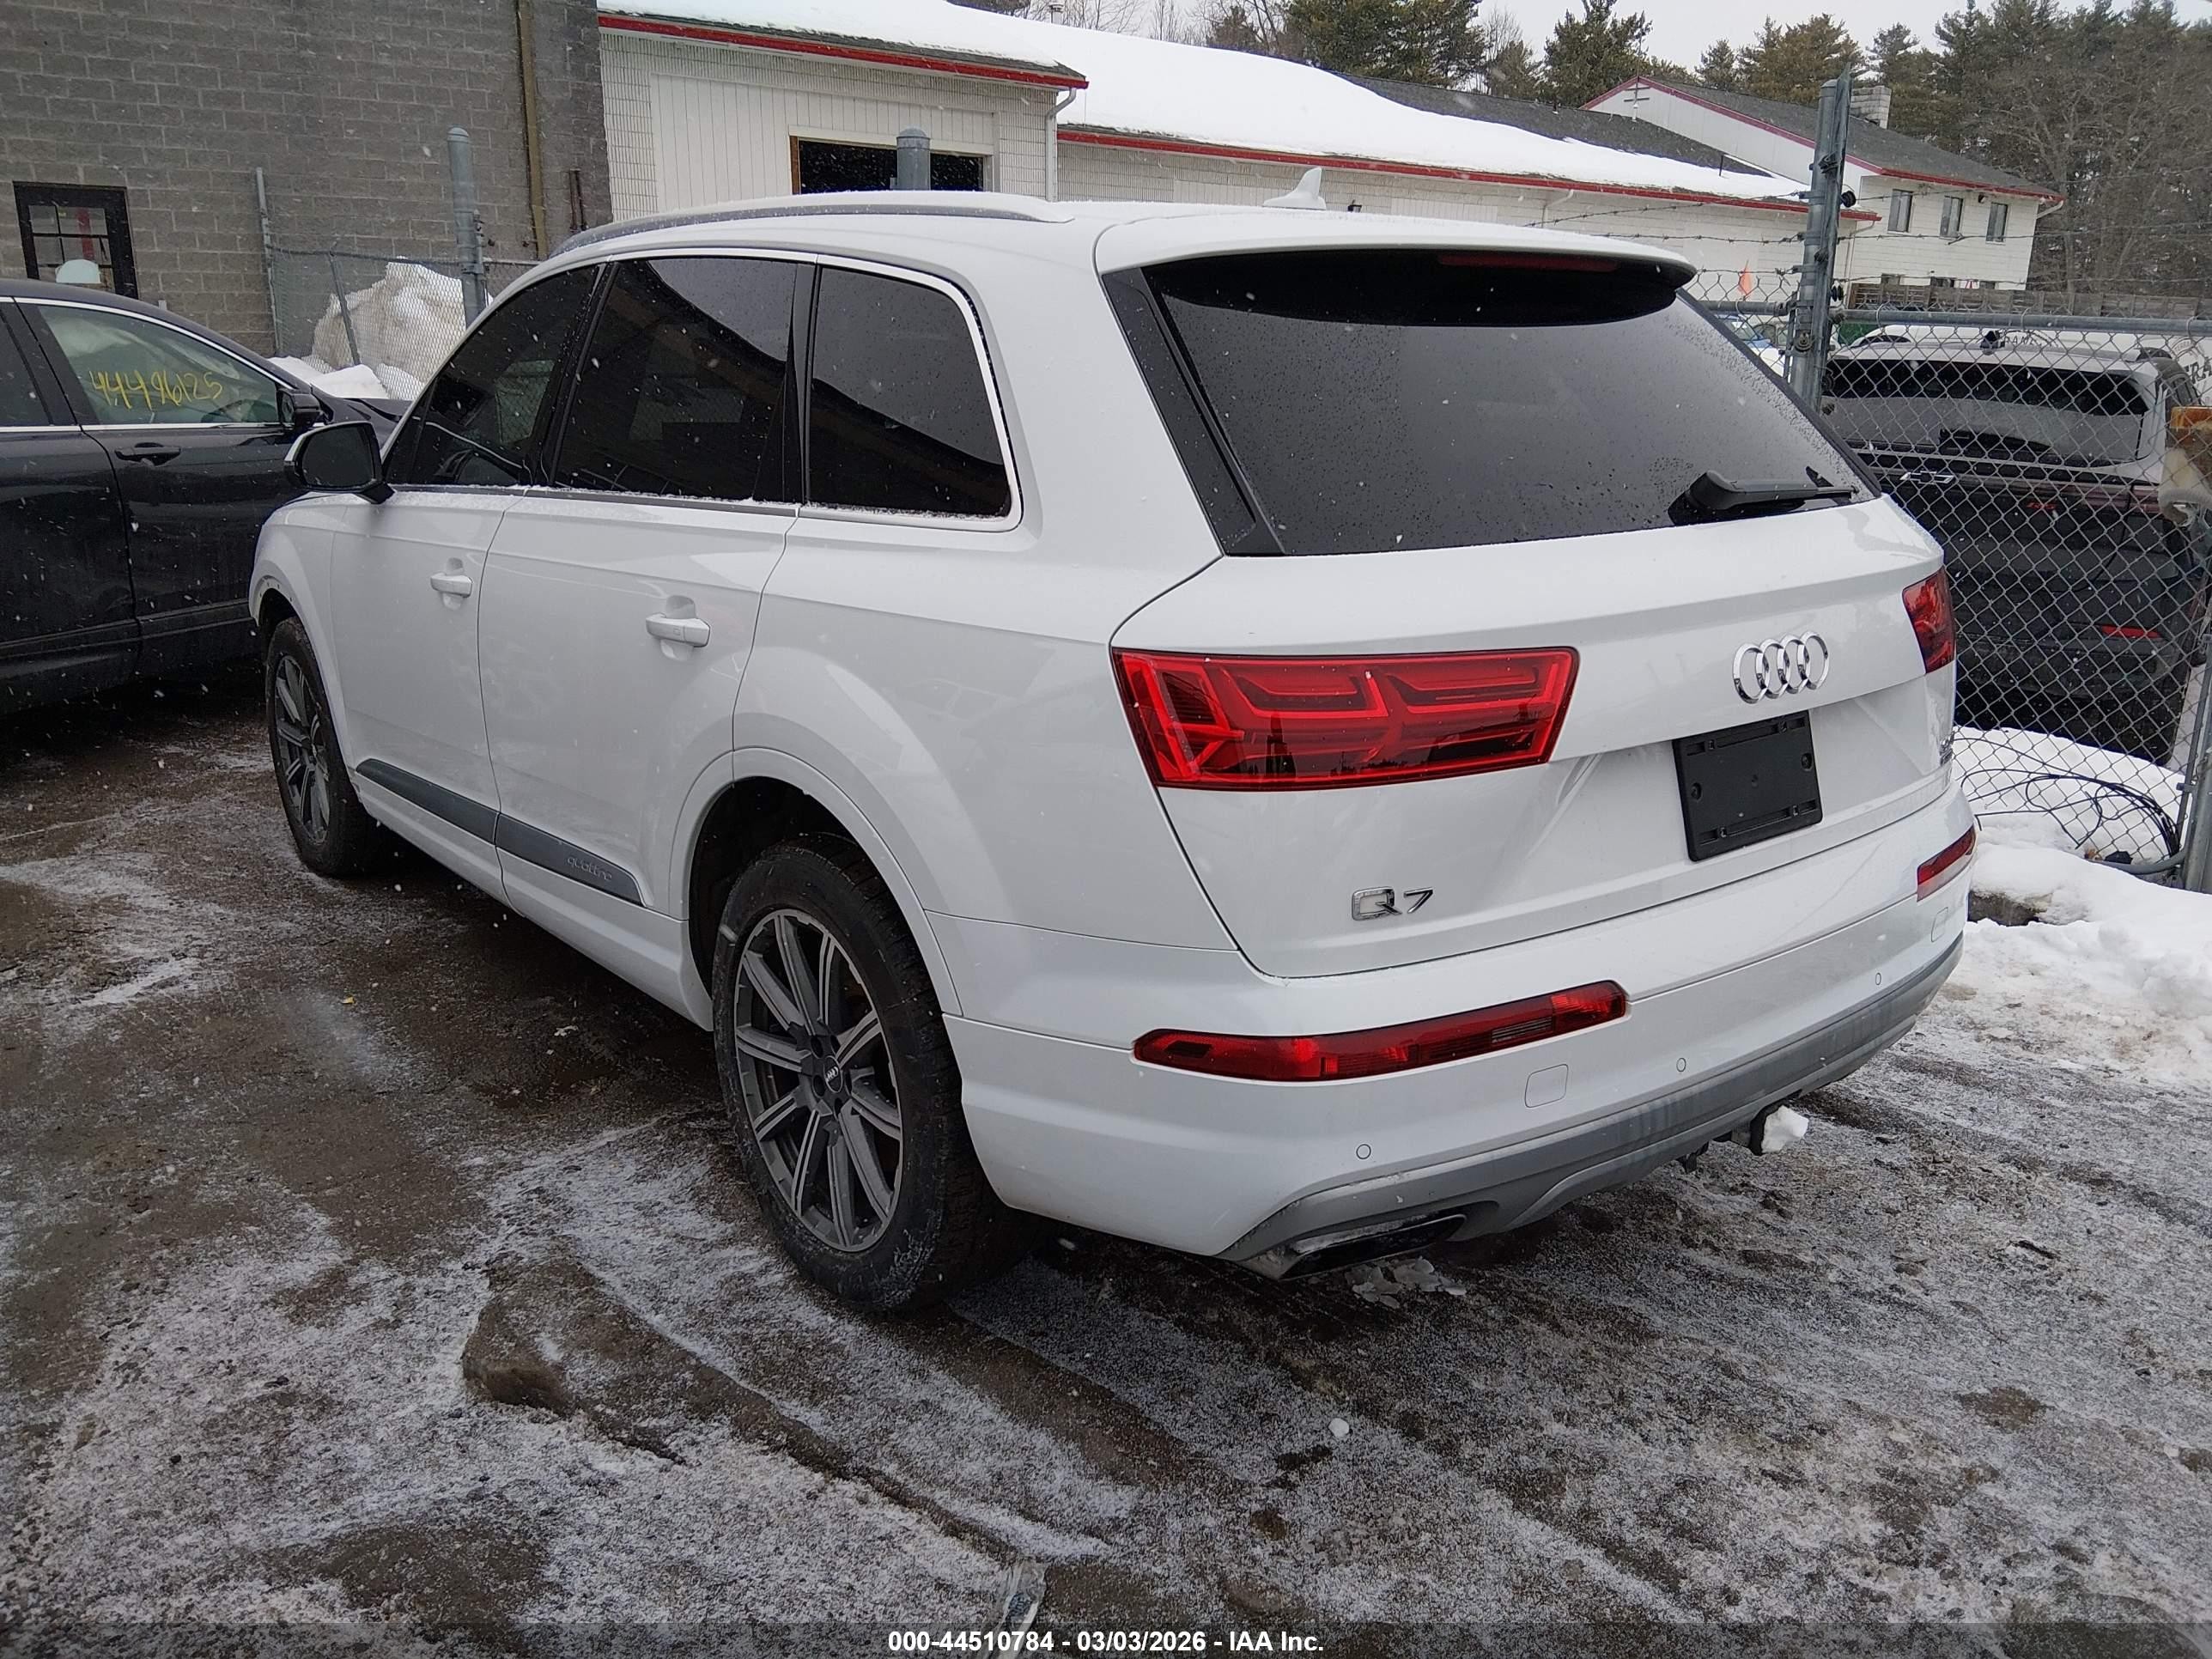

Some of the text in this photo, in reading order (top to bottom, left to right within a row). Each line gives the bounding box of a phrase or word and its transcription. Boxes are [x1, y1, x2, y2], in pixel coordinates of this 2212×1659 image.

[89, 370, 222, 410] 44496125
[567, 856, 612, 881] quattro
[1351, 886, 1433, 921] Q7
